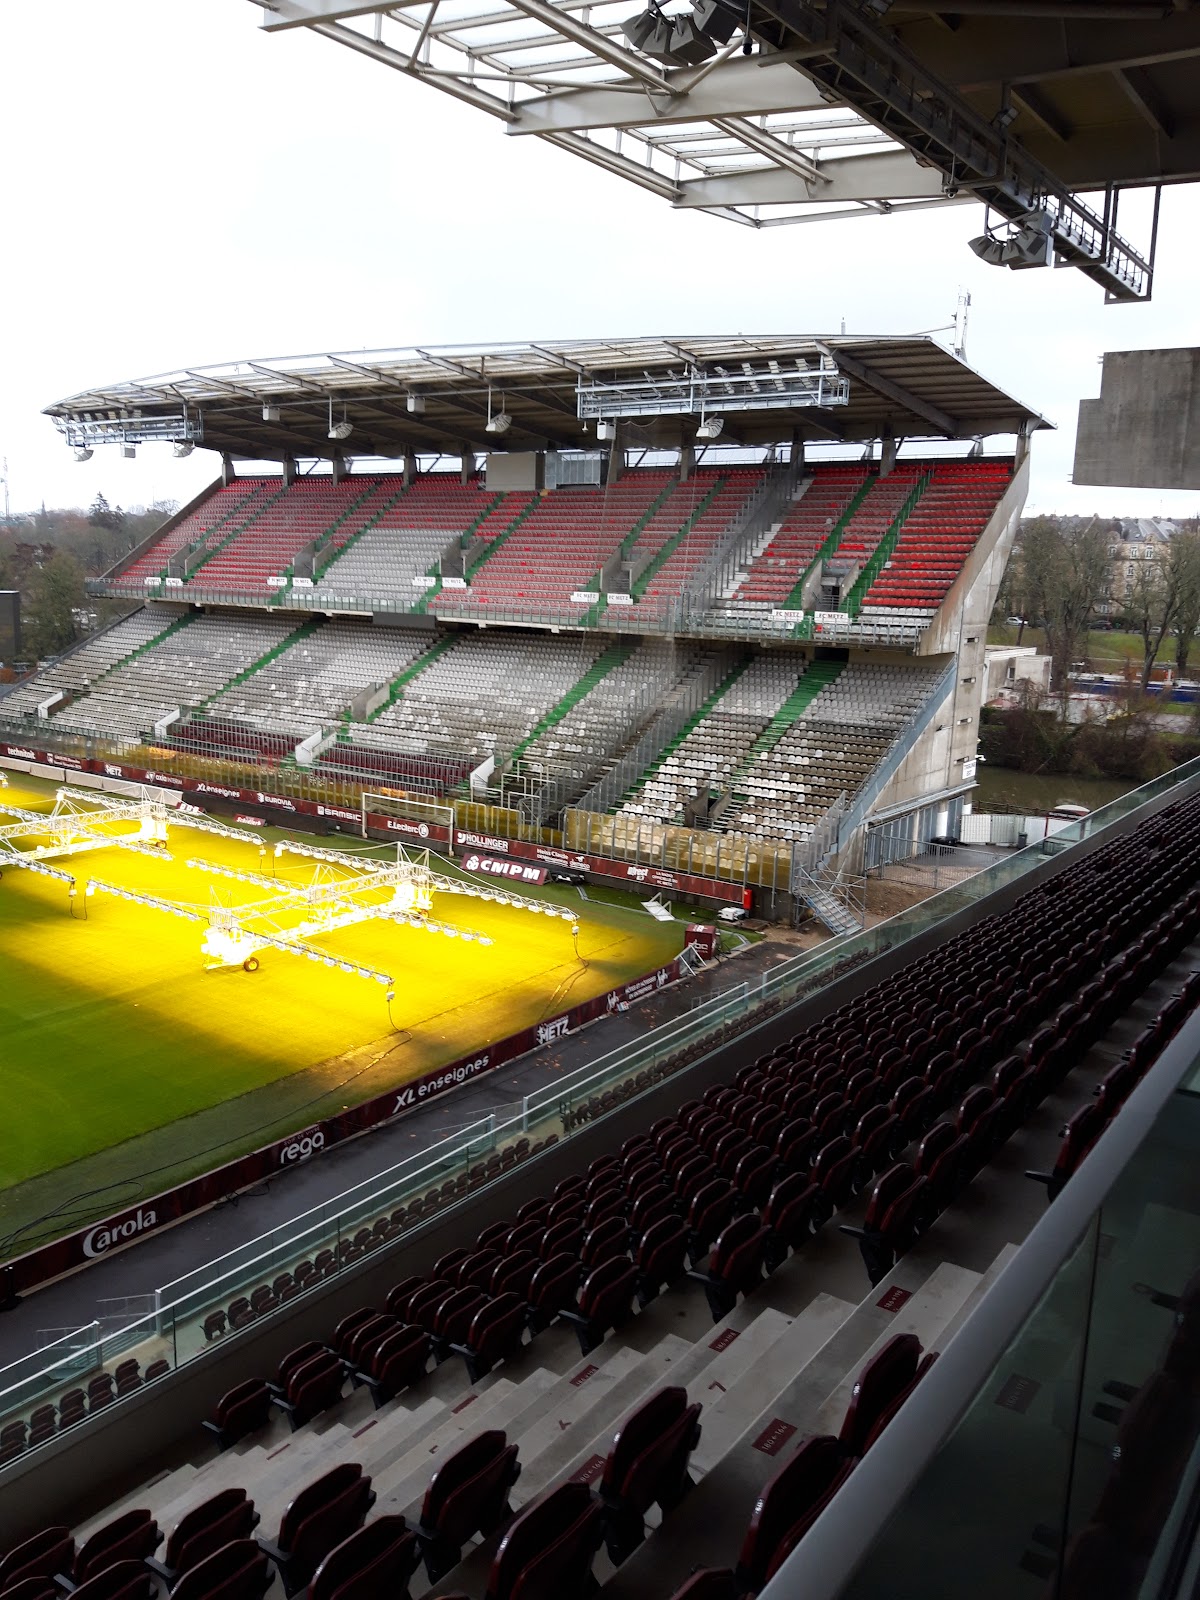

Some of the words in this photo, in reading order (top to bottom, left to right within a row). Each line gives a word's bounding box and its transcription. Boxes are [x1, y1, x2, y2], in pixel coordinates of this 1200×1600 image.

[196, 783, 206, 792] XL
[206, 786, 240, 798] enseignes
[324, 808, 362, 822] SAMSIC
[387, 820, 418, 834] E.Leclerc
[466, 834, 508, 850] HOLLINGER
[537, 1018, 569, 1044] METZ
[392, 1088, 416, 1114] XL
[418, 1055, 490, 1097] enseignes
[82, 1209, 157, 1258] Carola
[762, 1439, 774, 1450] 180
[774, 1424, 788, 1435] 164
